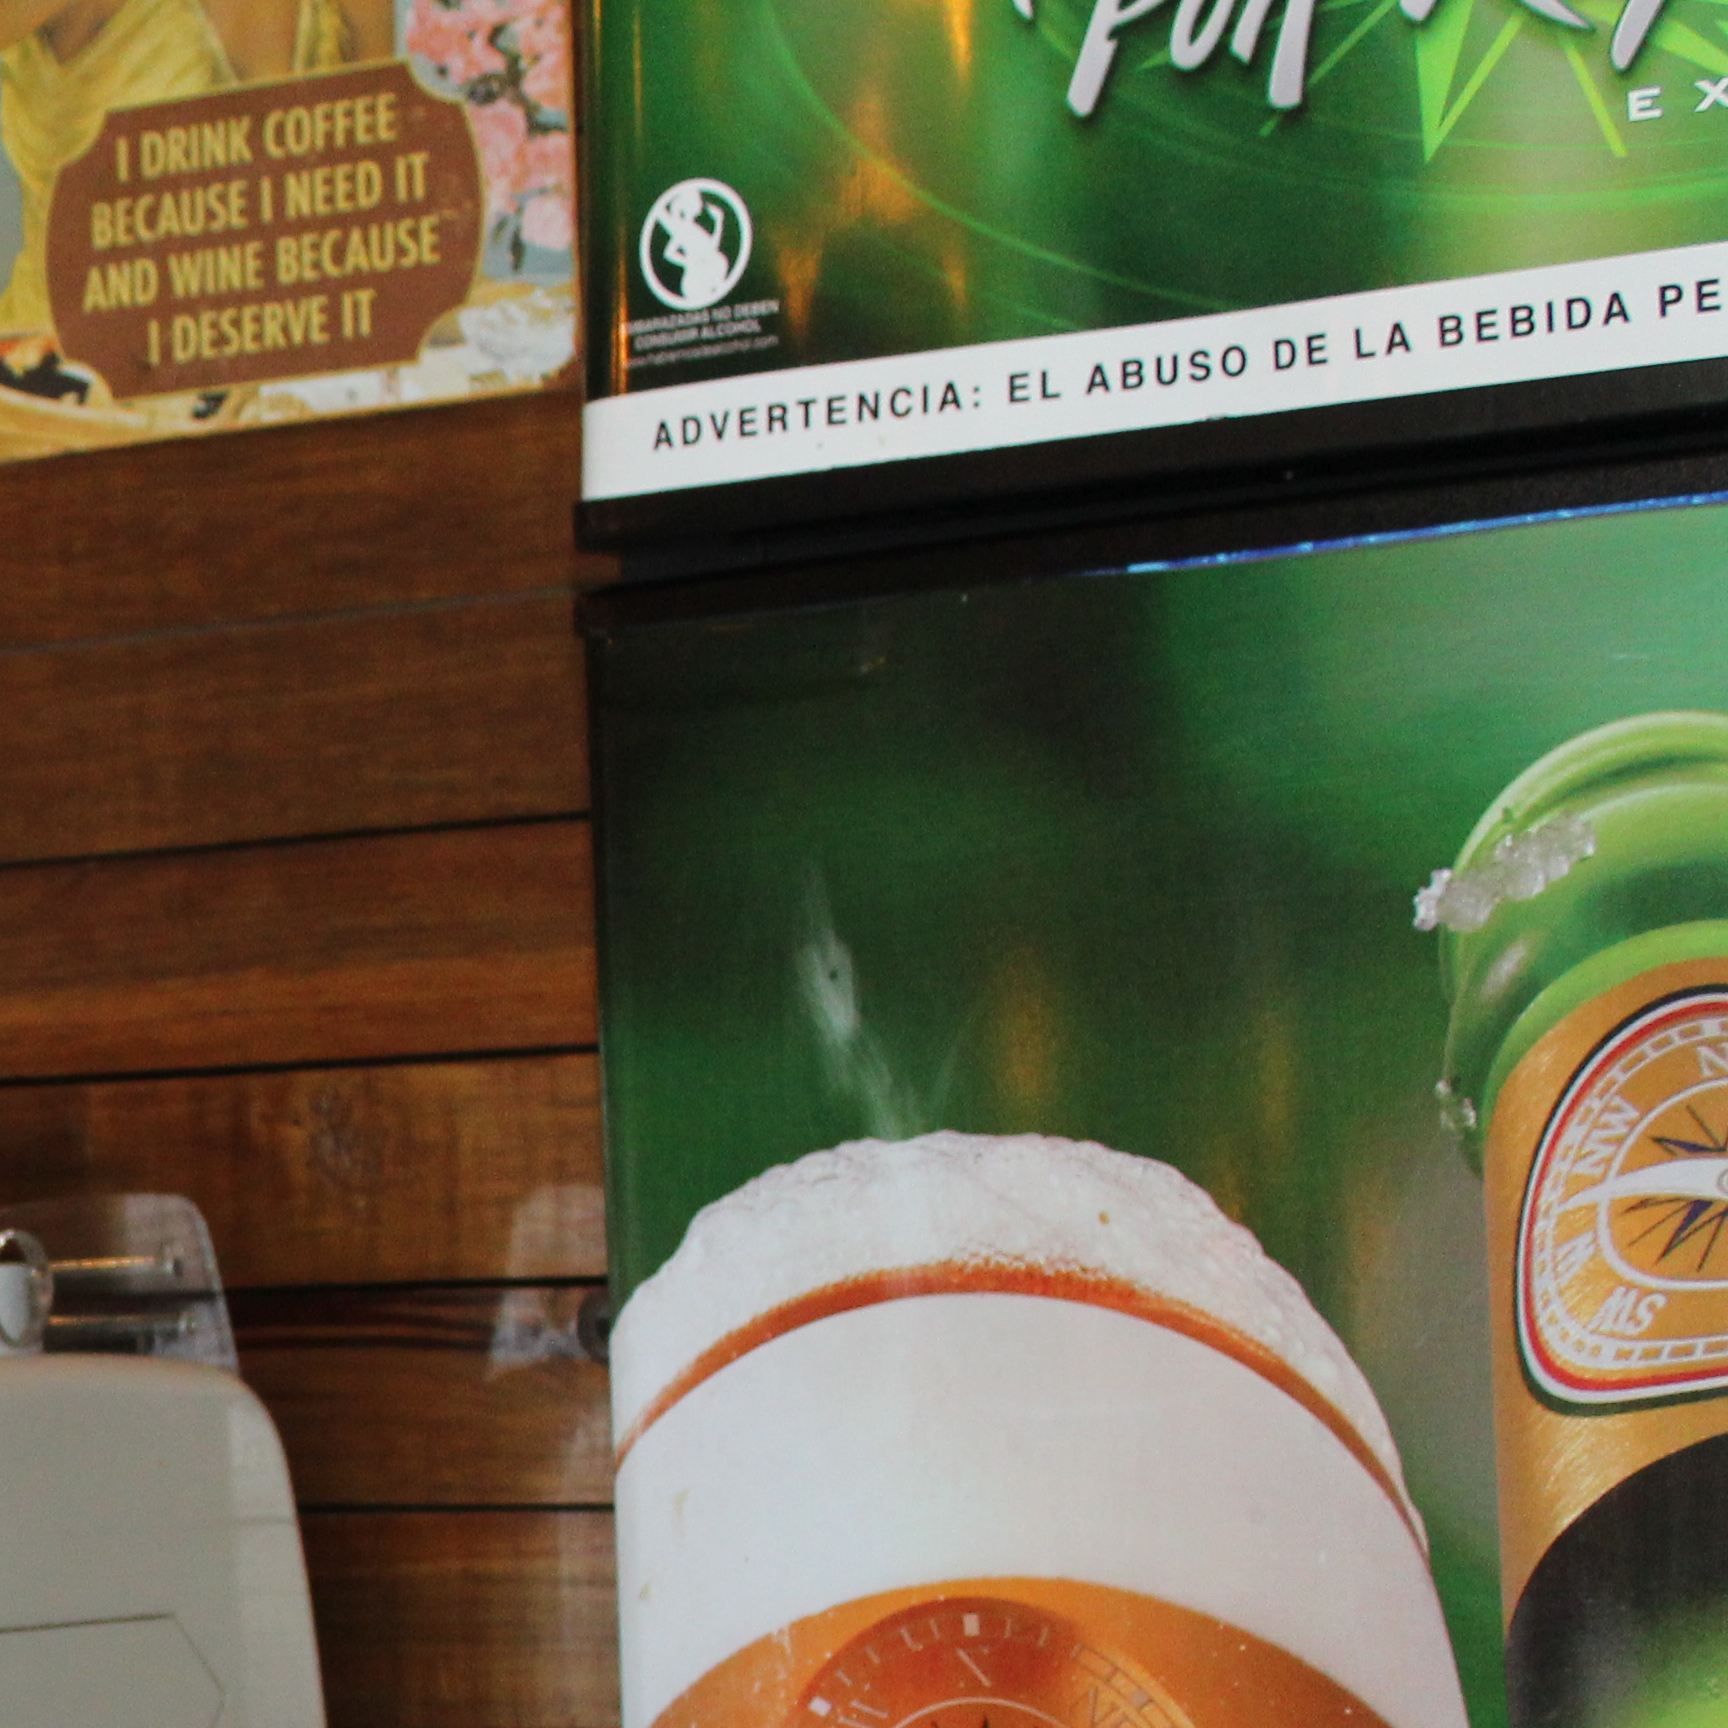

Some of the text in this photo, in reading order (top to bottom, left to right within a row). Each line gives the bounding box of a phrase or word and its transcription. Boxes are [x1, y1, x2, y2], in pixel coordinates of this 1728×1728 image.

[115, 92, 397, 183] I DRINK COFFEE
[90, 151, 430, 250] BECAUSE I NEED IT
[82, 214, 441, 313] AND WINE BECAUSE
[148, 288, 377, 367] I DESERVE IT
[653, 277, 1722, 452] ADVERTENCIA: EL ABUSO DE LA BEBIDA PE
[1586, 1285, 1668, 1337] SW
